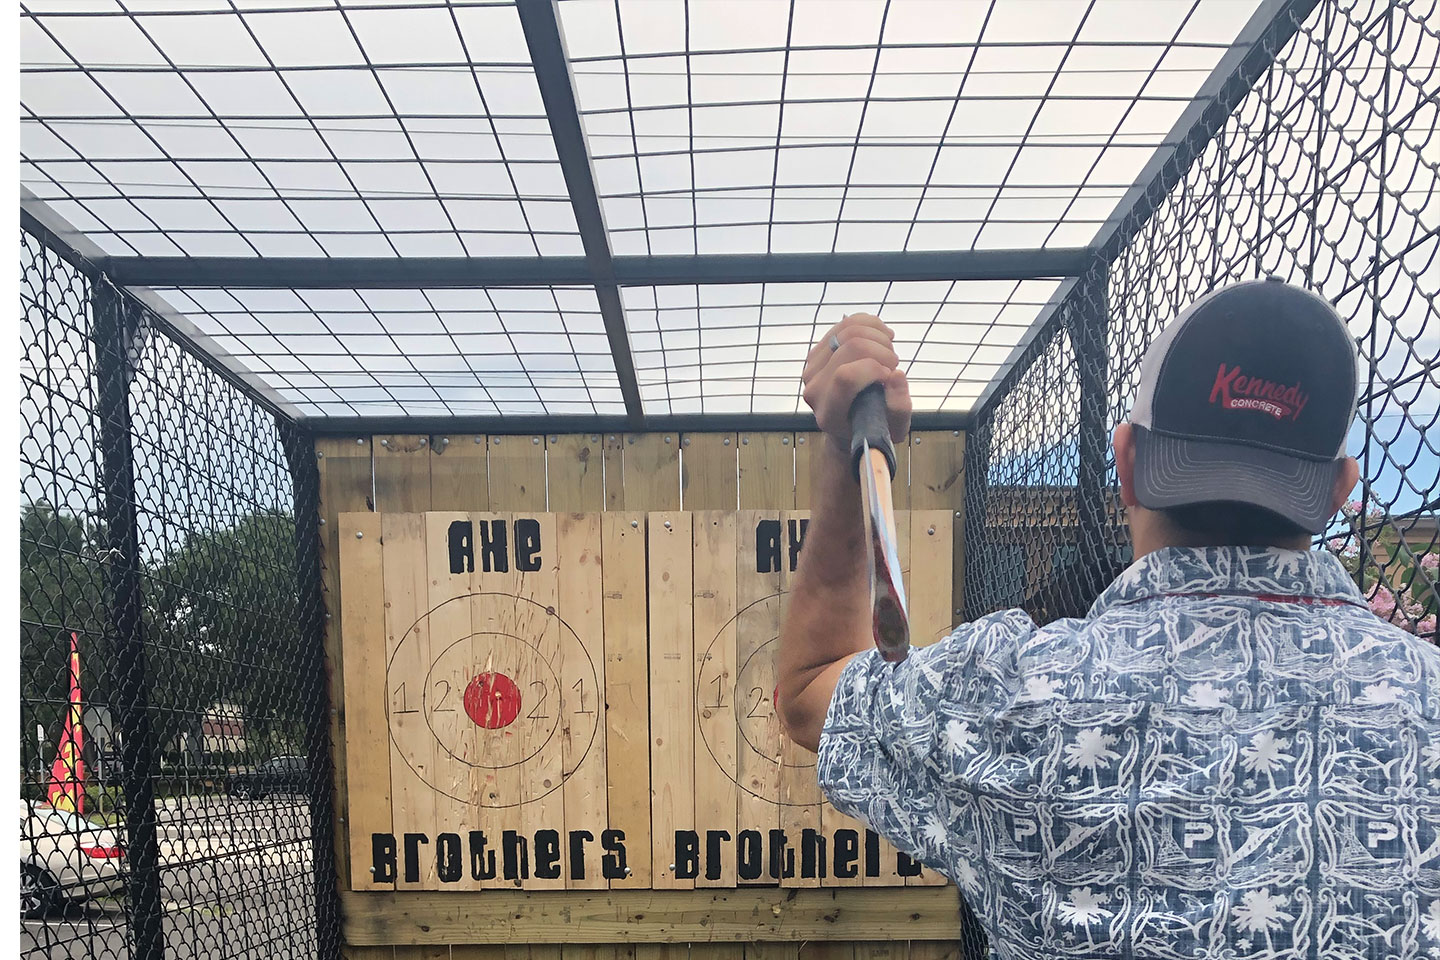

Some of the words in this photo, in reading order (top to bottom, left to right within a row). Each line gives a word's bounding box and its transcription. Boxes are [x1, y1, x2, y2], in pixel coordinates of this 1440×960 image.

[1210, 363, 1308, 421] Kennedy
[1230, 398, 1282, 417] CONCRETE
[756, 519, 810, 574] AX
[393, 682, 419, 714] 1
[434, 680, 456, 713] 2
[526, 681, 549, 720] 2
[572, 680, 594, 715] 1
[704, 675, 729, 709] 1
[746, 686, 768, 720] 2
[371, 828, 628, 884] Brothers
